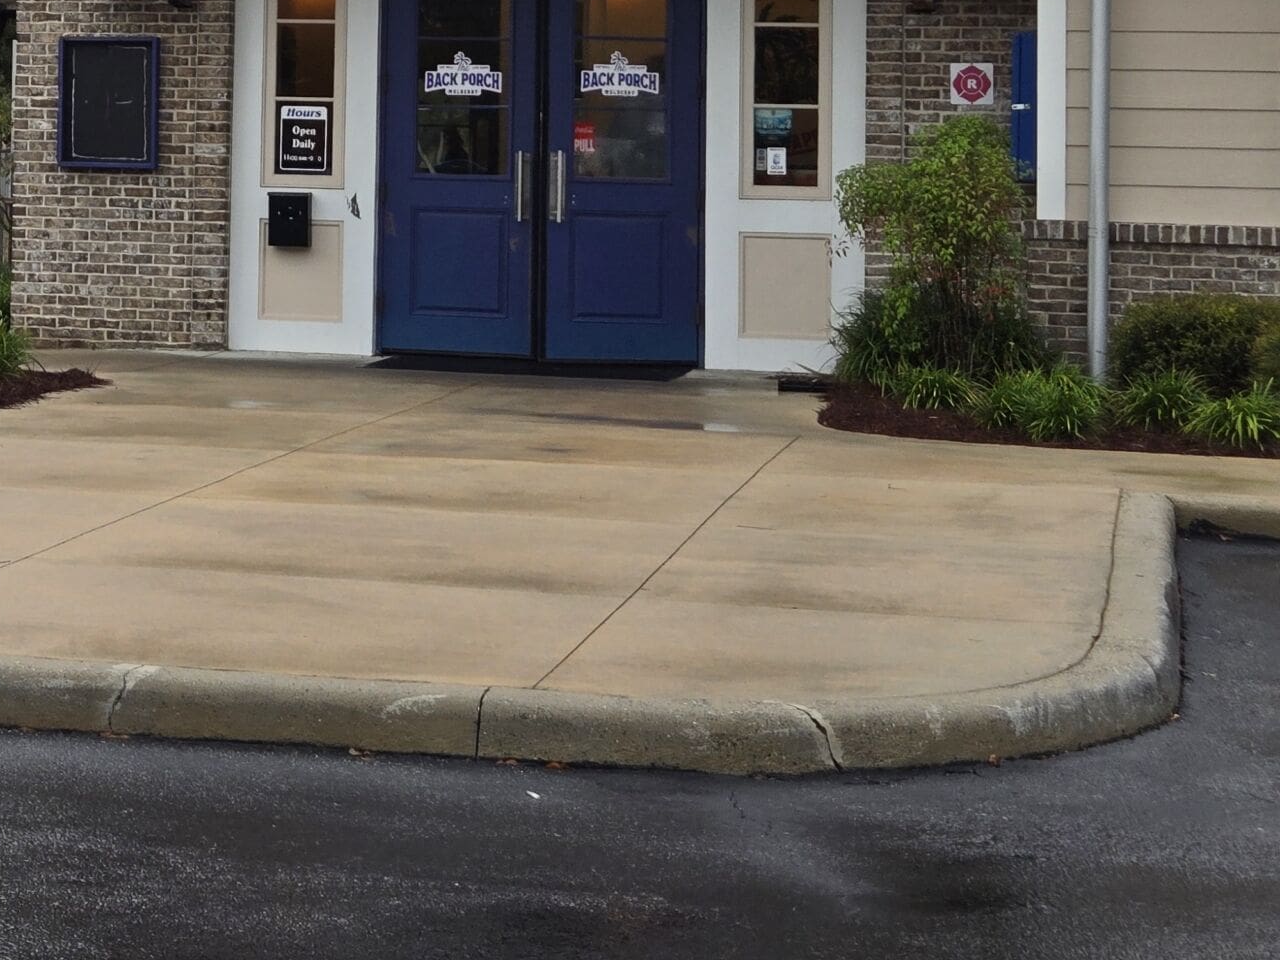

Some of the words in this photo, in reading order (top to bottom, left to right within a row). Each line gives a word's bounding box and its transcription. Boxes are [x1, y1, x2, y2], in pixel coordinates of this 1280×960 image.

[426, 72, 458, 89] BACK
[461, 72, 500, 90] PORCH
[582, 72, 615, 89] BACK
[618, 73, 657, 91] PORCH
[967, 78, 977, 89] R
[286, 108, 322, 118] Hours
[292, 125, 316, 136] Open
[292, 138, 316, 150] Daily
